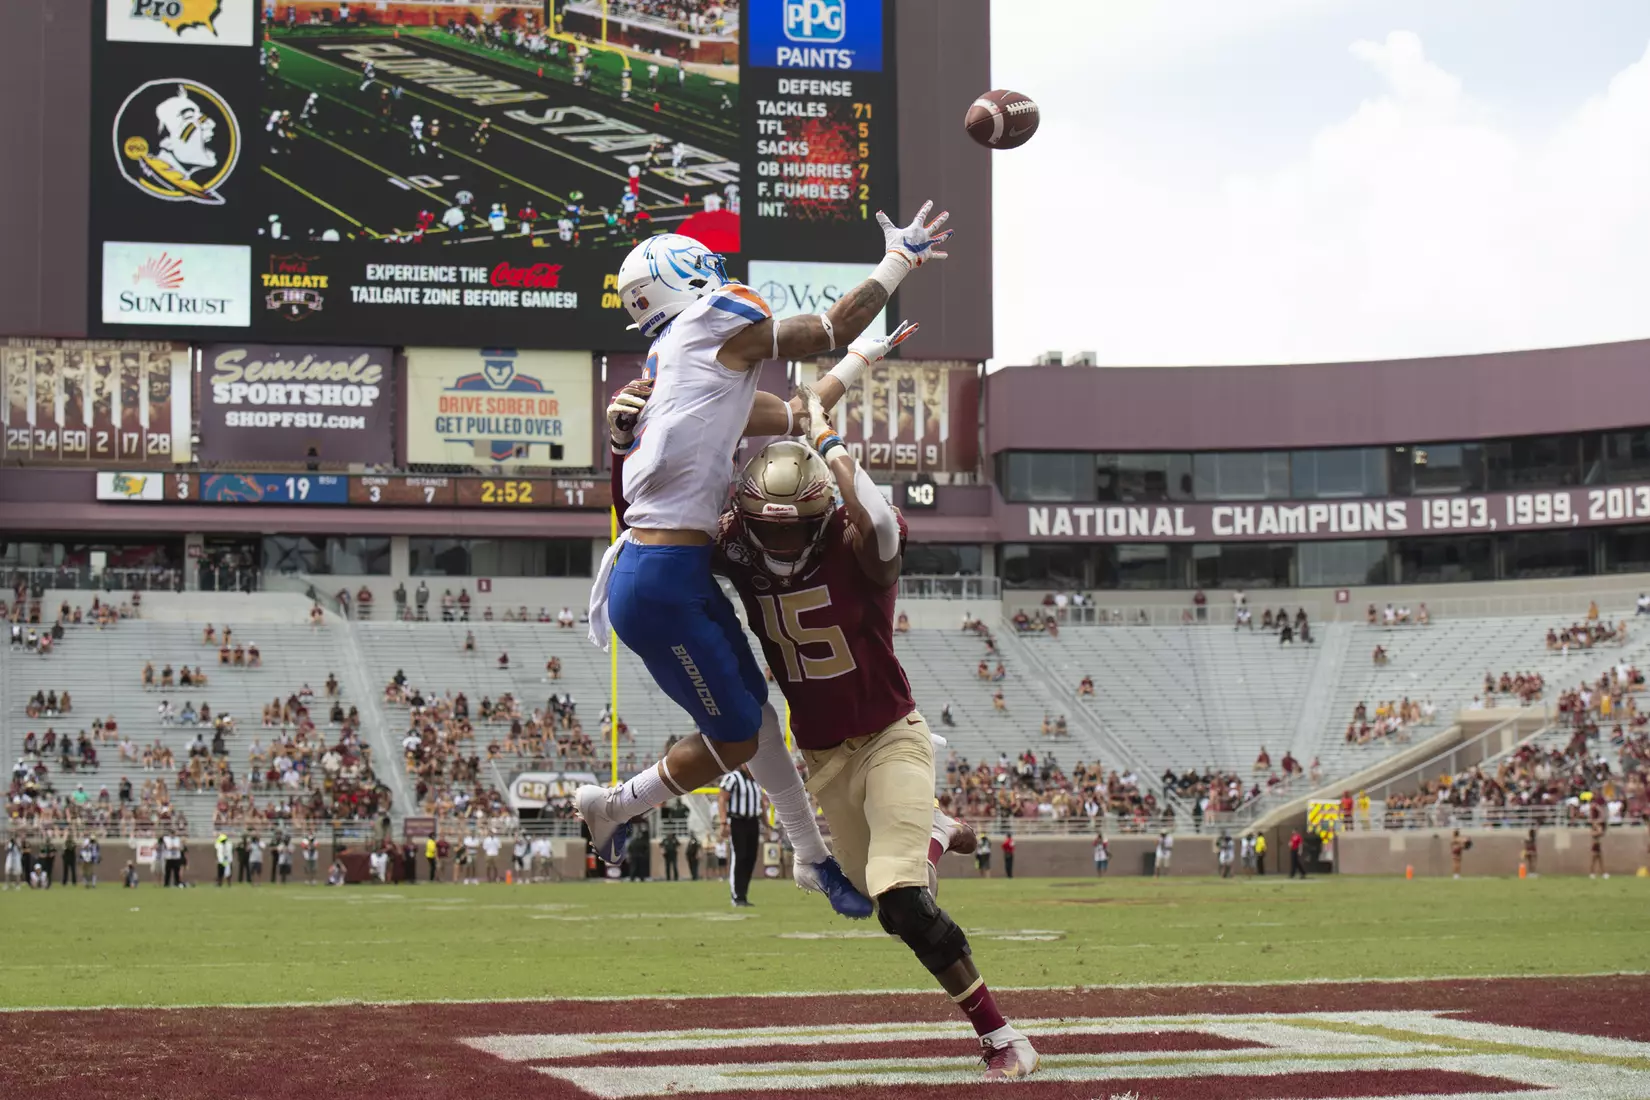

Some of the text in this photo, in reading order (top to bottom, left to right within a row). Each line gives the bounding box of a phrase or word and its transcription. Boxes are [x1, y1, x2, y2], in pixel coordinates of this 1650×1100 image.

[133, 0, 181, 16] Pro
[788, 0, 842, 36] PPG
[776, 46, 853, 69] PAINTS
[778, 78, 853, 97] DEFENSE
[756, 100, 872, 119] TACKLES 71
[756, 119, 869, 138] TFL 5
[756, 140, 869, 158] SACKS 5
[757, 161, 869, 179] QB HURRIES 7
[757, 182, 870, 200] F. FUMBLES 2
[757, 202, 868, 220] INT. 1
[261, 274, 328, 288] TAILGATE
[366, 264, 457, 283] EXPERIENCE
[460, 267, 488, 283] THE
[351, 286, 577, 308] TAILGATE ZONE BEFORE GAMES!
[210, 349, 383, 384] Seminole
[212, 382, 380, 407] SPORTSHOP
[439, 396, 560, 416] DRIVE SOBER OR
[435, 417, 563, 436] GET PULLED OVER
[7, 430, 170, 454] 25 34 50 2 17 28
[870, 443, 891, 464] 27
[896, 444, 917, 464] 55
[926, 445, 938, 465] 9
[177, 482, 189, 499] 3
[286, 477, 310, 500] 19
[361, 477, 389, 486] DOWN
[405, 477, 448, 488] DISTANCE
[557, 480, 579, 489] BALL
[369, 486, 381, 502] 3
[424, 487, 436, 503] 7
[481, 481, 533, 504] 2:52
[564, 490, 585, 505] 11
[908, 484, 934, 505] 40
[1028, 486, 1650, 536] NATIONAL CHAMPIONS 1993, 1999, 2013
[756, 584, 857, 682] 15
[671, 644, 721, 716] BRONCOS
